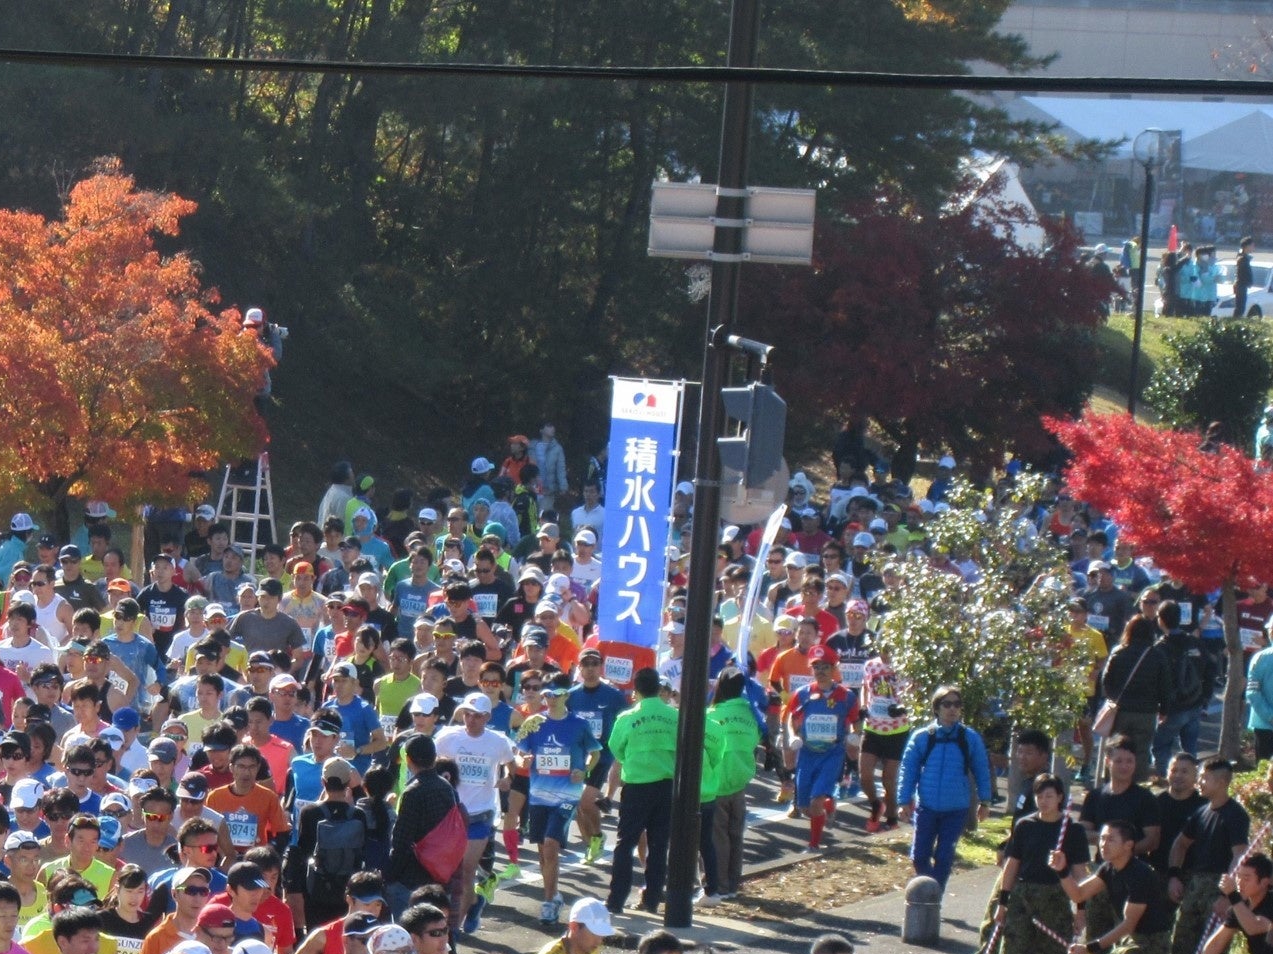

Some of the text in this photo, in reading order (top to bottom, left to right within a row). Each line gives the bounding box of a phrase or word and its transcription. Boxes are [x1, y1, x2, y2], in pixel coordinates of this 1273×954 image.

[616, 438, 659, 625] 積水ハウス
[539, 756, 559, 768] 381
[229, 813, 248, 822] Step
